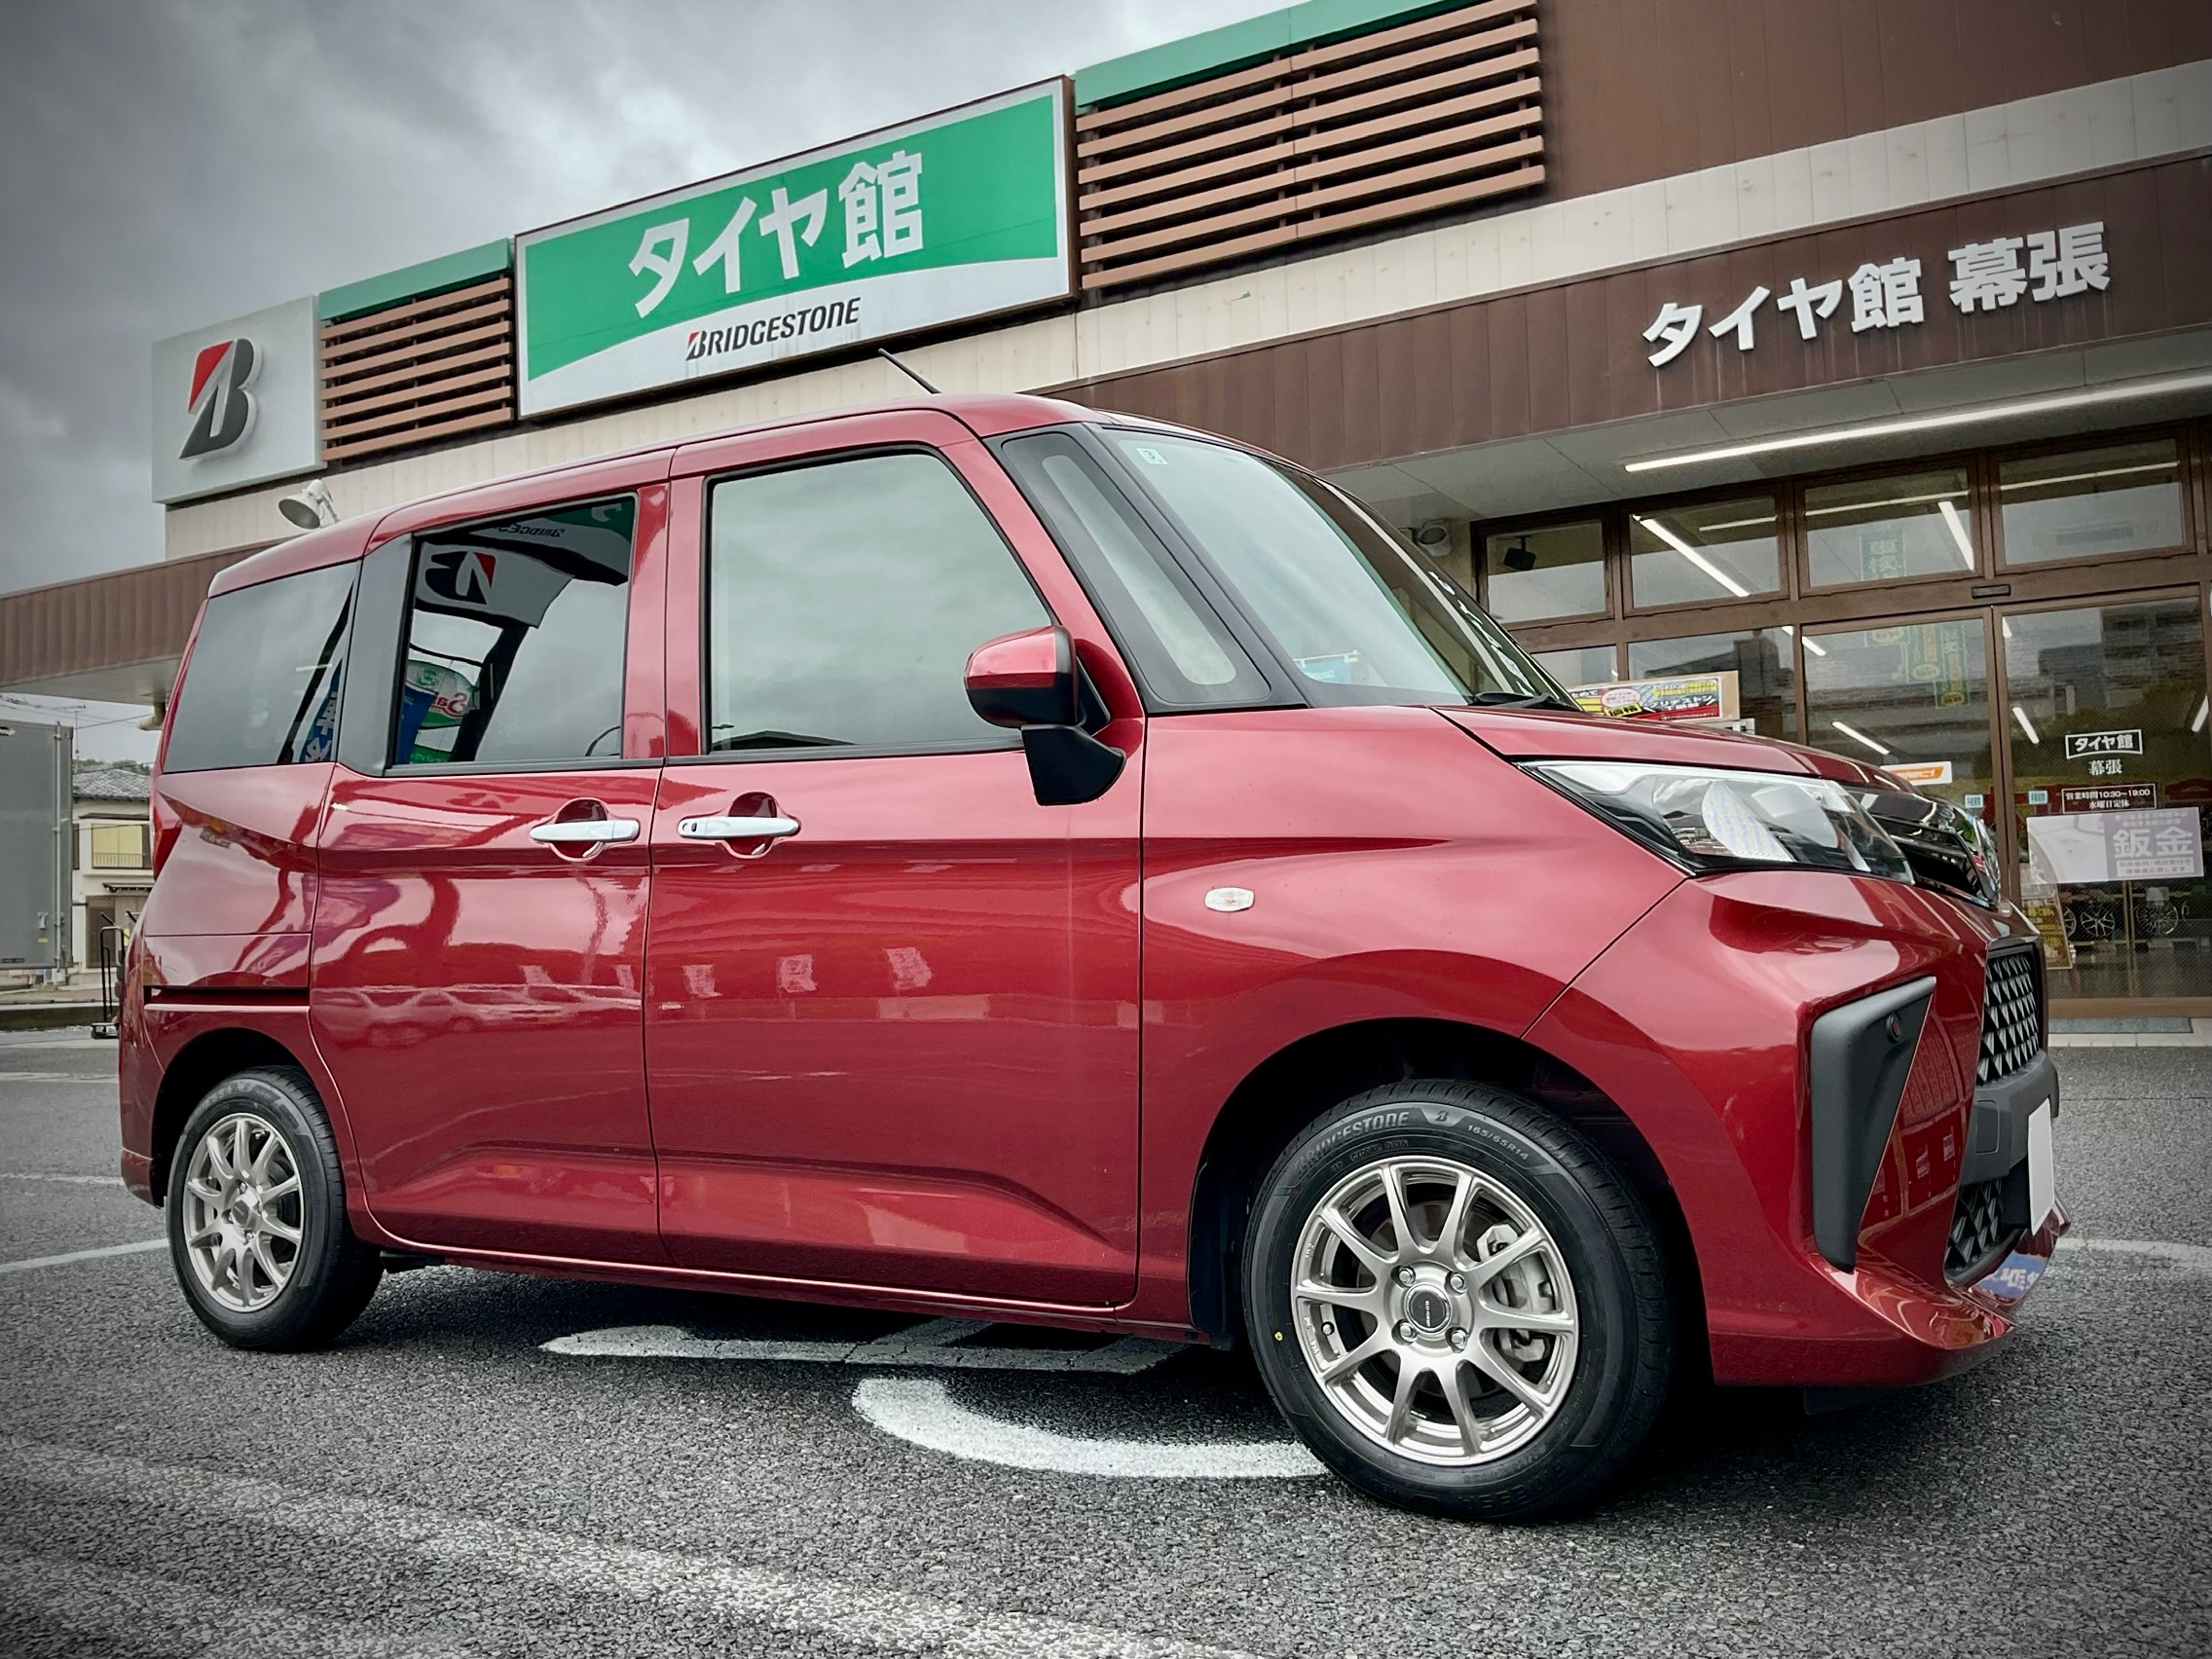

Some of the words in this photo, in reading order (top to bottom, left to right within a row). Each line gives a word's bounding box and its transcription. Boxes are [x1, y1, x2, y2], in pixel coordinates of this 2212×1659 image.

[628, 149, 924, 318] タイヤ館
[1642, 256, 1926, 368] タイヤ館
[1948, 221, 2110, 314] 幕張
[685, 296, 861, 362] BRIDGESTONE
[2075, 734, 2134, 753] タイヤ館
[2088, 758, 2122, 776] 幕張
[2113, 826, 2194, 859] 鈑金
[1467, 1124, 1530, 1161] 165/65R14
